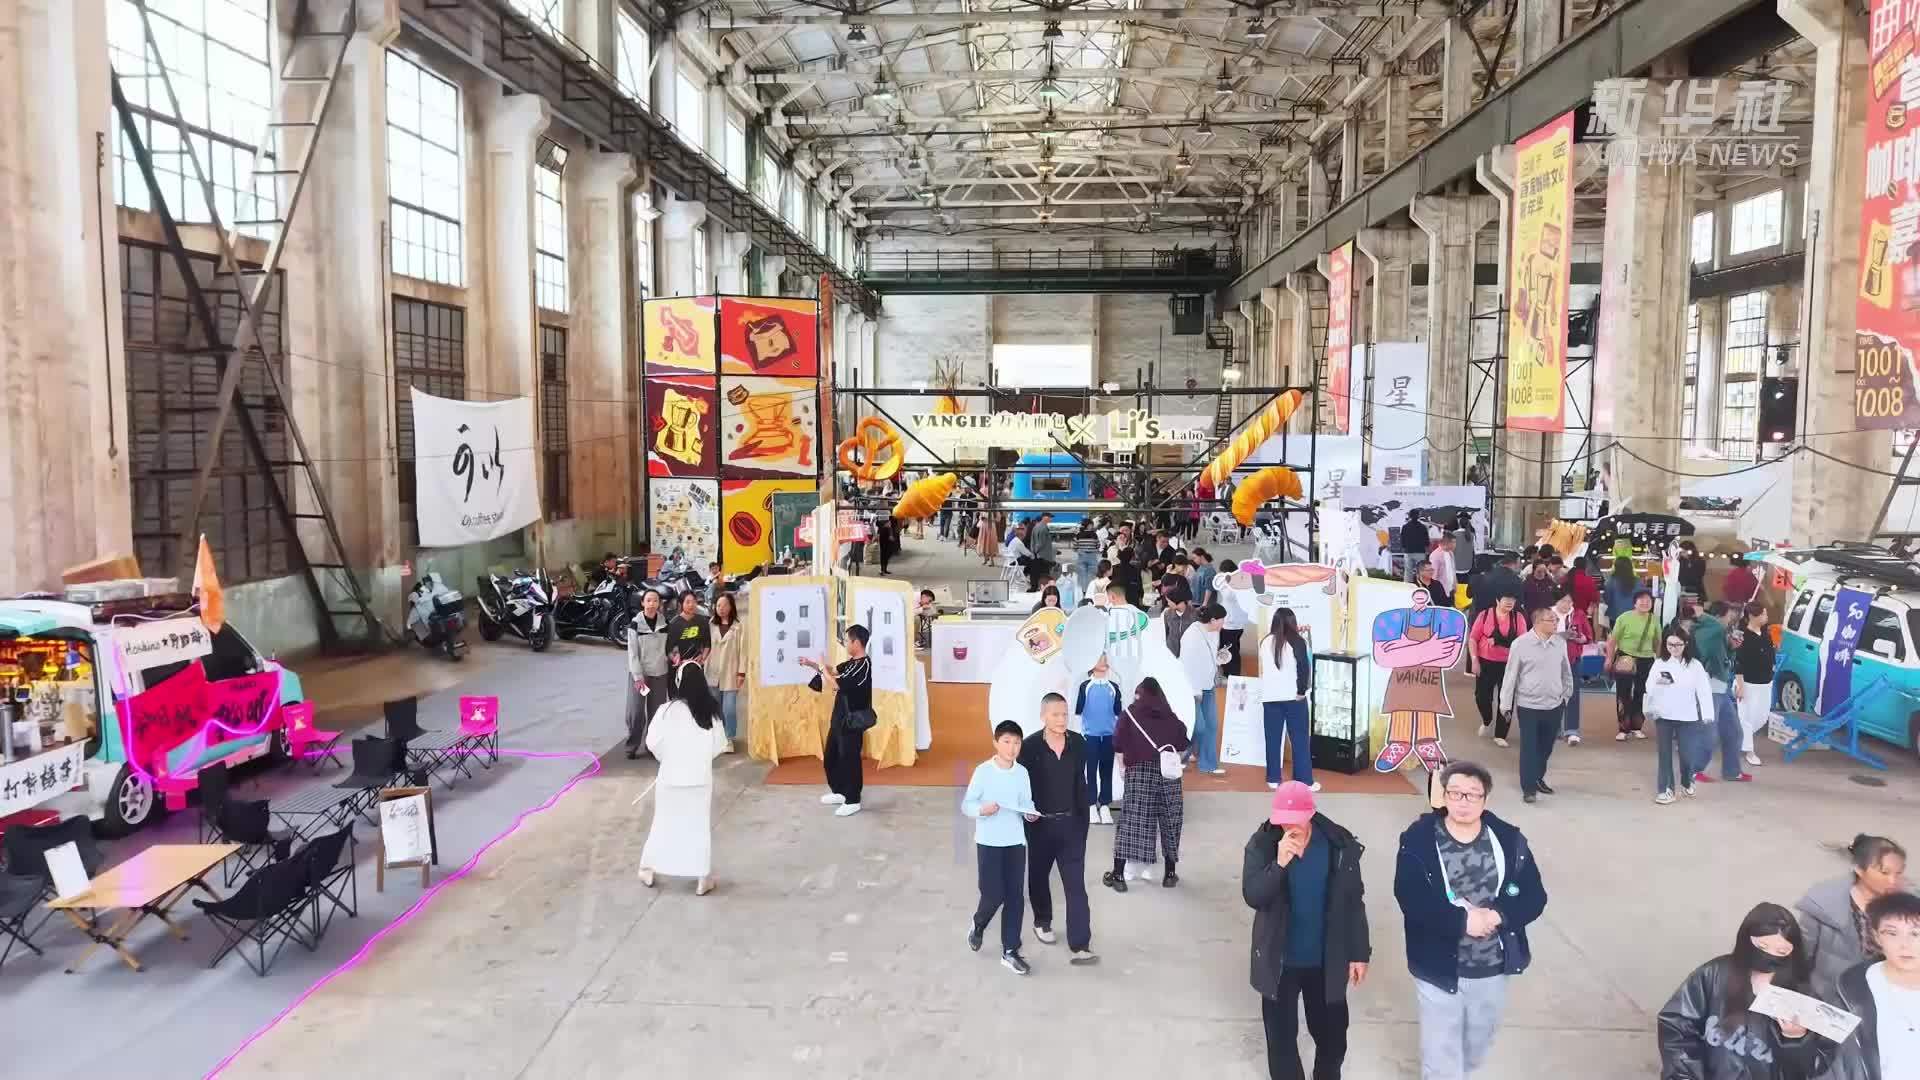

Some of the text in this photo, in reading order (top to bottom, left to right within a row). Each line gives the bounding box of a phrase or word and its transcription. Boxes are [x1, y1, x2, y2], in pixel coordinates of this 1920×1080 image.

[1385, 376, 1417, 409] 星
[912, 414, 992, 428] VANGIE
[1319, 468, 1347, 501] 星
[1395, 669, 1441, 686] VANGIE
